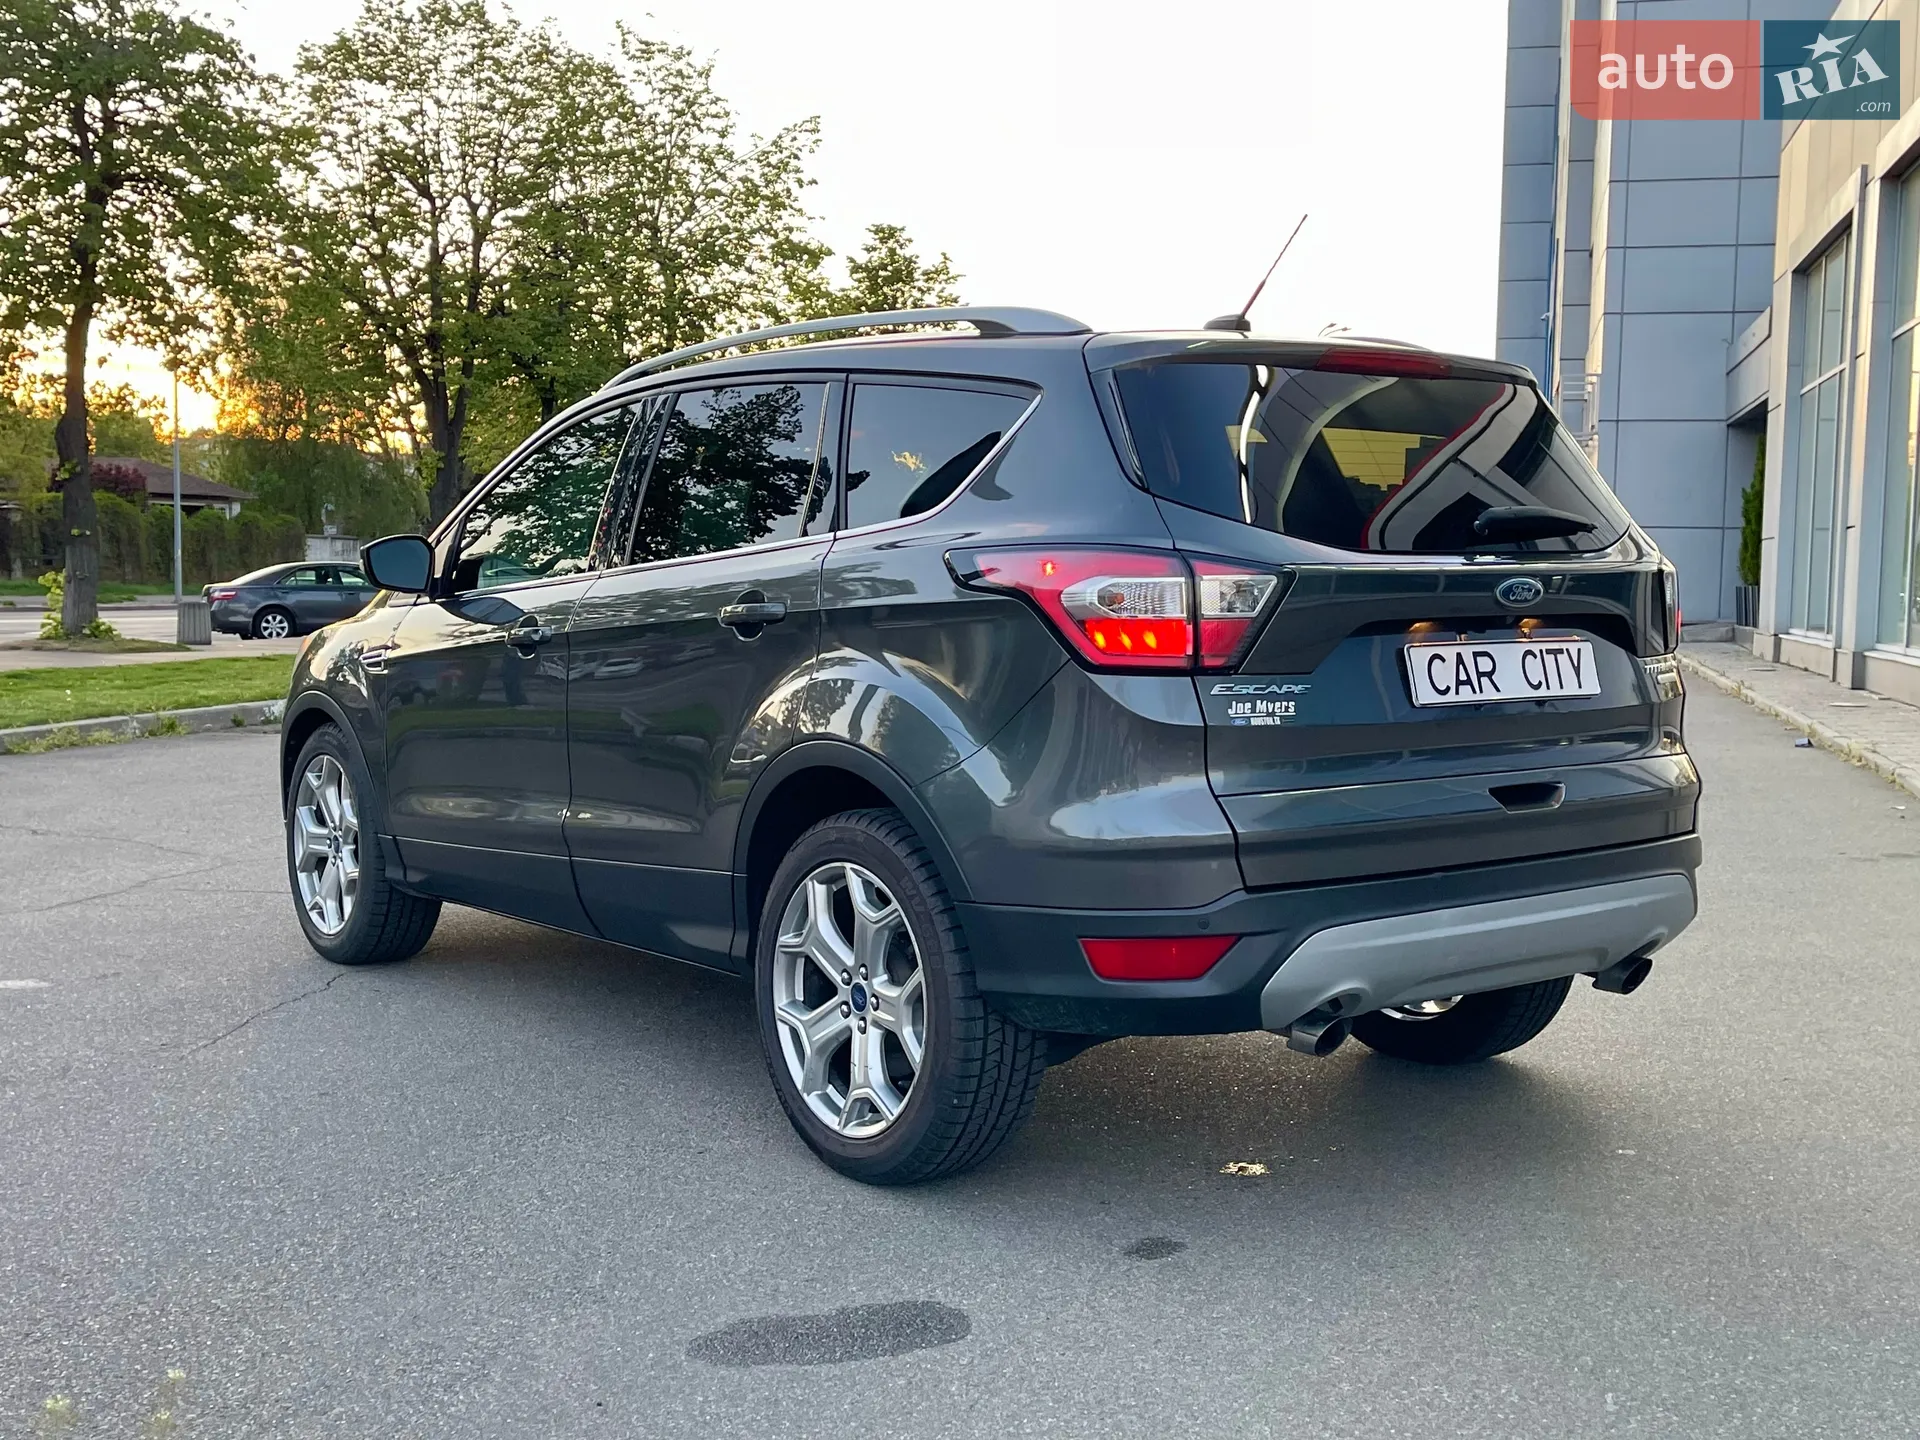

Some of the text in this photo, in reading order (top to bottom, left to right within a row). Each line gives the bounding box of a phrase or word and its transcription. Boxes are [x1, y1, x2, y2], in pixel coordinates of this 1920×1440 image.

[1426, 647, 1583, 696] CAR CITY
[1210, 683, 1311, 695] ESCAPE
[1227, 701, 1252, 714] Joe
